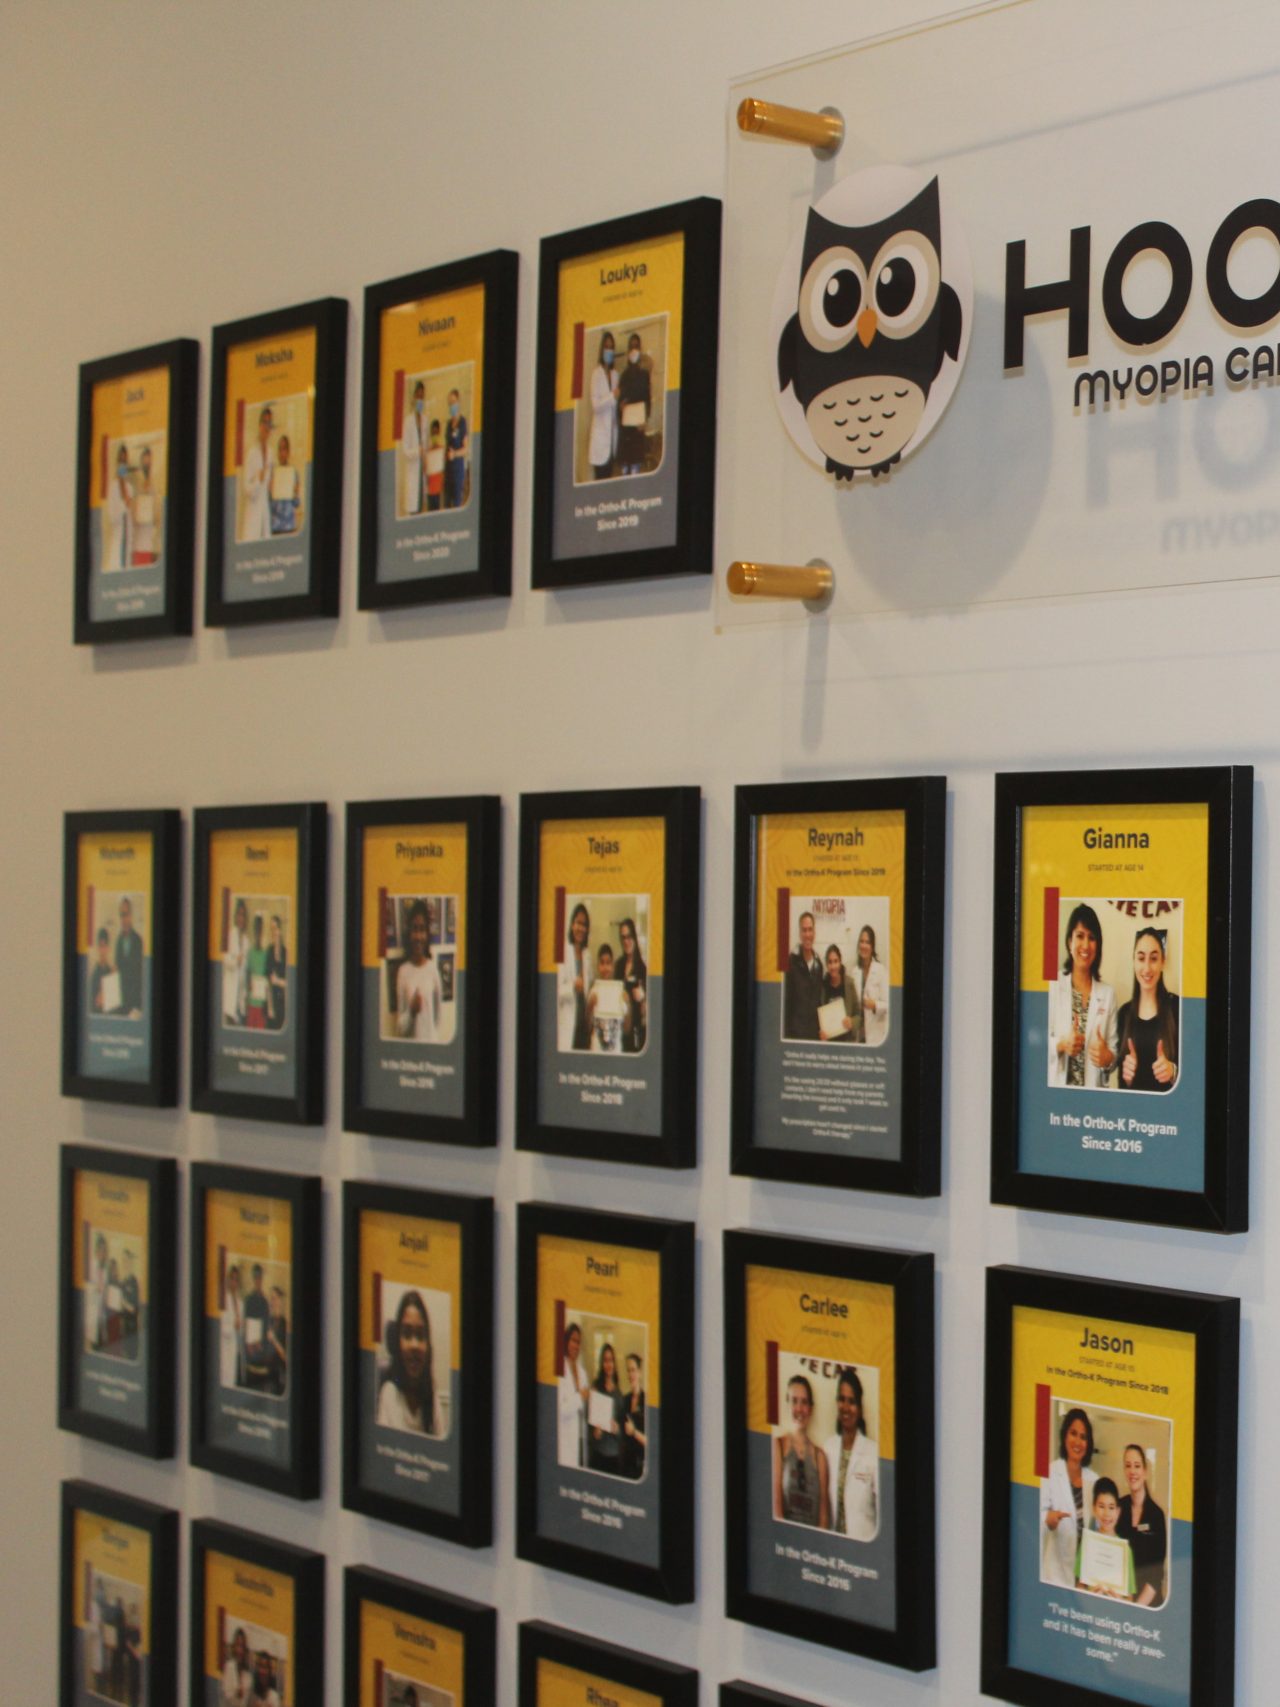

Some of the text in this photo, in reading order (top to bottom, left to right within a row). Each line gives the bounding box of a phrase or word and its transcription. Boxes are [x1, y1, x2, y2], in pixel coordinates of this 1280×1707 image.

[600, 263, 647, 286] Loukya
[1074, 355, 1214, 407] MYOPIA
[629, 496, 662, 511] Program
[587, 837, 620, 861] Tejas
[808, 828, 864, 851] Reynah
[1083, 827, 1149, 849] Gianna
[395, 842, 443, 861] Priyanka
[1088, 864, 1113, 872] STARTED
[1050, 1113, 1177, 1136] In the Ortho-K Program
[1082, 1136, 1142, 1153] Since 2016
[586, 1256, 620, 1278] Pearl
[800, 1294, 848, 1318] Carlee
[1079, 1327, 1134, 1356] Jason
[1097, 1374, 1127, 1388] Program
[1129, 1380, 1149, 1392] Since
[775, 1543, 878, 1579] In the Ortho-K Program
[801, 1567, 825, 1584] Since
[1070, 1608, 1093, 1623] been
[1095, 1616, 1121, 1634] using
[1123, 1622, 1161, 1641] Ortho-K
[1043, 1619, 1060, 1631] and
[1062, 1620, 1068, 1632] it
[1070, 1624, 1086, 1638] has
[1088, 1629, 1112, 1645] been
[1113, 1638, 1140, 1655] really
